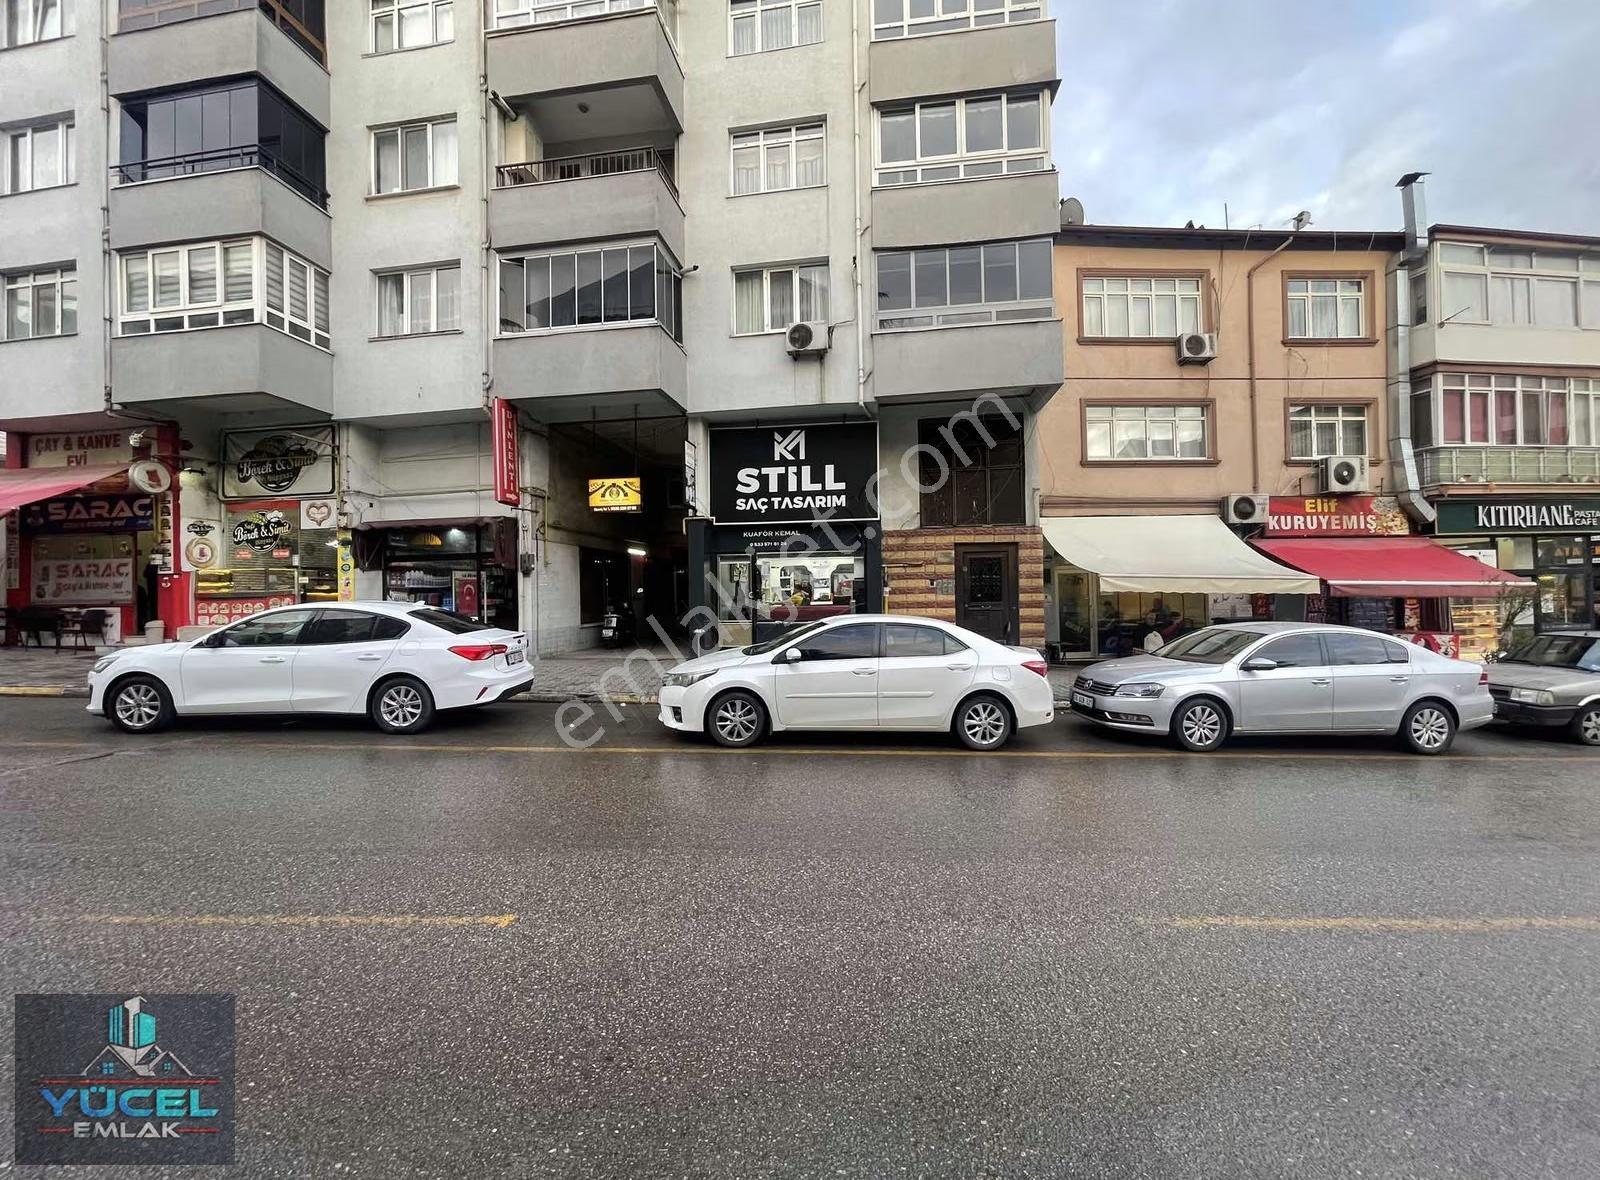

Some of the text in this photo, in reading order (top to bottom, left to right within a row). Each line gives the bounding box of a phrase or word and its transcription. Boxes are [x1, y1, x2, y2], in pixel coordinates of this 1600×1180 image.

[736, 495, 846, 514] SAÇ TASARIM
[1304, 498, 1338, 513] Elif
[1268, 511, 1377, 534] KURUYEMİŞ
[1477, 504, 1574, 528] KITIRHANE
[1574, 518, 1598, 526] CAFE
